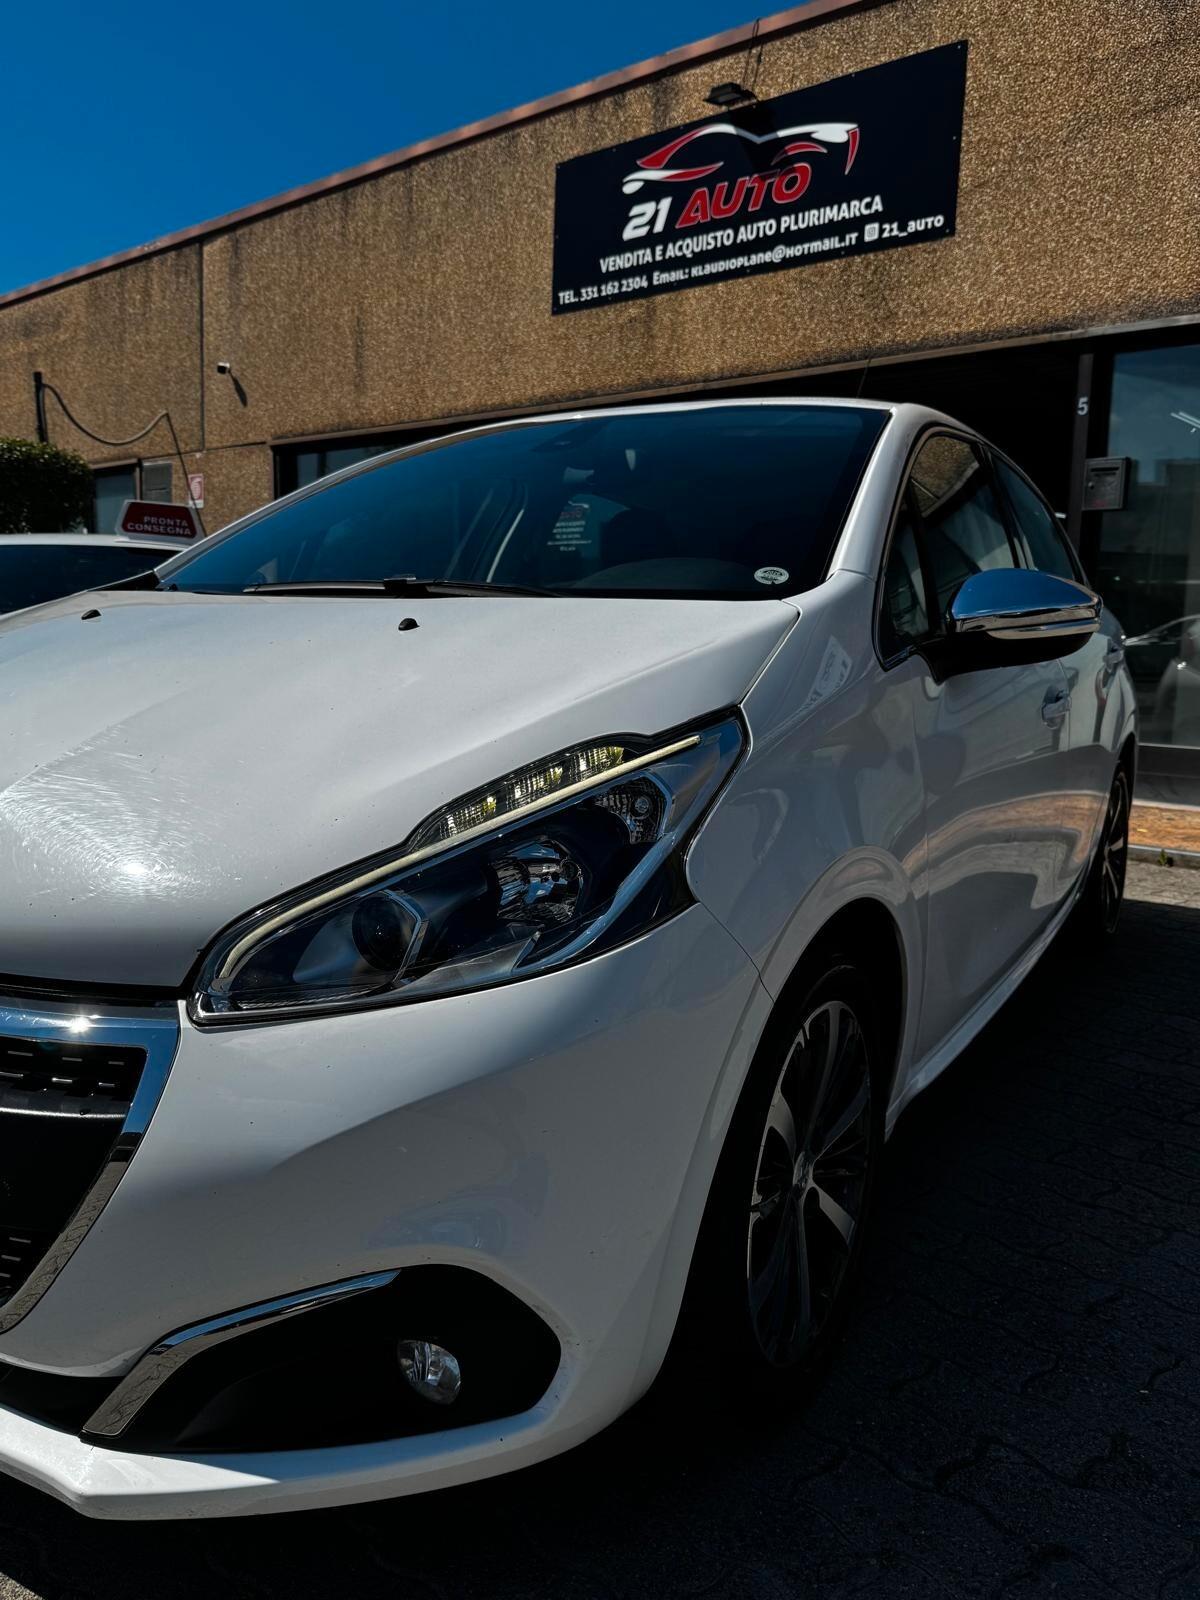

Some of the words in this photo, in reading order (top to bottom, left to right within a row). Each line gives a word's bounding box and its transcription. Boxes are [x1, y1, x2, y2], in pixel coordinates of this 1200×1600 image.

[622, 196, 672, 242] 21
[675, 162, 811, 228] AUTO
[600, 248, 653, 273] VENDITA
[655, 246, 663, 261] E
[665, 228, 734, 259] ACQUISTO
[737, 219, 777, 243] AUTO
[780, 195, 884, 233] PLURIMARCA
[558, 290, 579, 305] TEL.
[580, 286, 598, 301] 331
[600, 282, 619, 296] 162
[621, 275, 648, 291] 2304
[1077, 396, 1089, 416] 5
[127, 522, 191, 535] CONSEGNA
[143, 516, 189, 527] PRONTA
